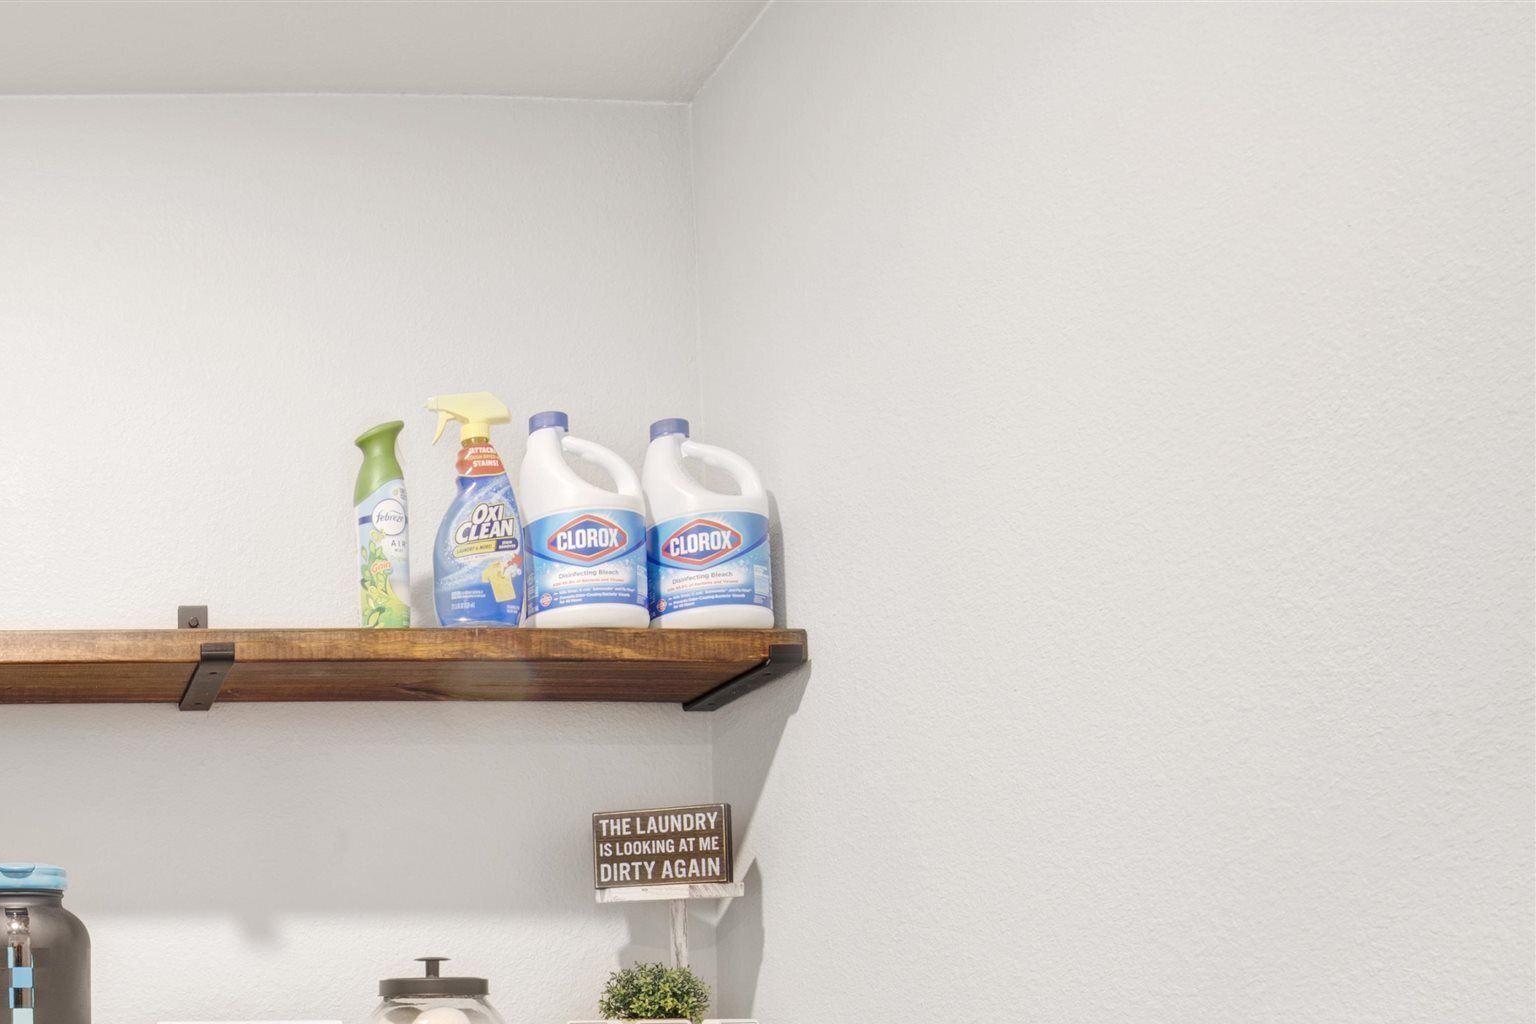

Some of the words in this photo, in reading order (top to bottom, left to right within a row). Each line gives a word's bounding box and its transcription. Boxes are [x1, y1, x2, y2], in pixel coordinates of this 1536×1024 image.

[456, 519, 514, 543] CLEAN
[556, 528, 619, 550] CLOROX
[670, 531, 732, 556] CLOROX
[371, 560, 391, 574] Gain
[559, 570, 596, 579] Disinfecting
[672, 574, 709, 584] Disinfecting
[599, 819, 631, 836] THE
[636, 812, 717, 834] LAUNDRY
[600, 843, 612, 856] IS
[616, 839, 674, 856] LOOKING
[679, 838, 695, 852] AT
[699, 837, 719, 850] ME
[601, 861, 655, 882] DIRTY
[661, 858, 720, 879] AGAIN
